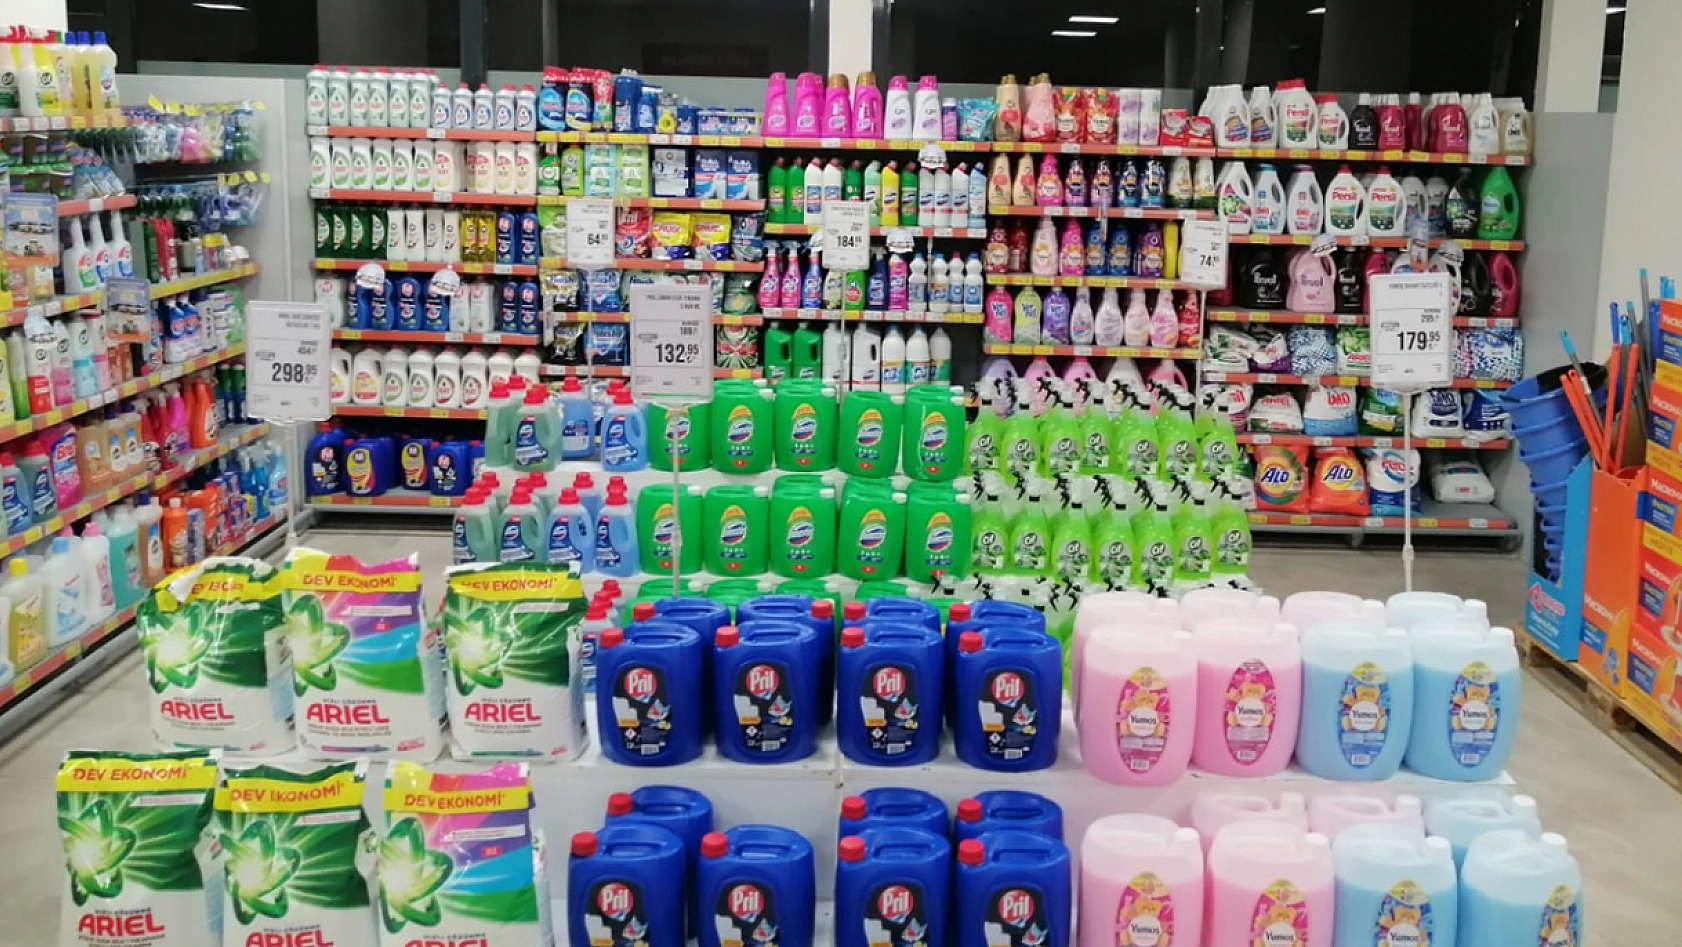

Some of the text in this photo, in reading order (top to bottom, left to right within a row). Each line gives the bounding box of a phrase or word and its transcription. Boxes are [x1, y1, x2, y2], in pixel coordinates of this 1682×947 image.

[303, 574, 333, 587] DEV
[629, 670, 653, 694] Pril
[750, 667, 775, 692] Pril
[877, 668, 900, 693] Pril
[996, 674, 1019, 698] Pril
[160, 700, 235, 721] ARIEL
[306, 703, 390, 725] ARIEL
[464, 702, 542, 723] ARIEL
[73, 767, 106, 781] DEV
[231, 788, 266, 802] DEV
[404, 793, 435, 807] DEV
[602, 887, 629, 912] Pril
[733, 888, 759, 913] Pril
[881, 887, 910, 915] Pril
[1001, 892, 1030, 918] Pril
[78, 913, 165, 937] ARIEL
[245, 929, 333, 947] ARIEL
